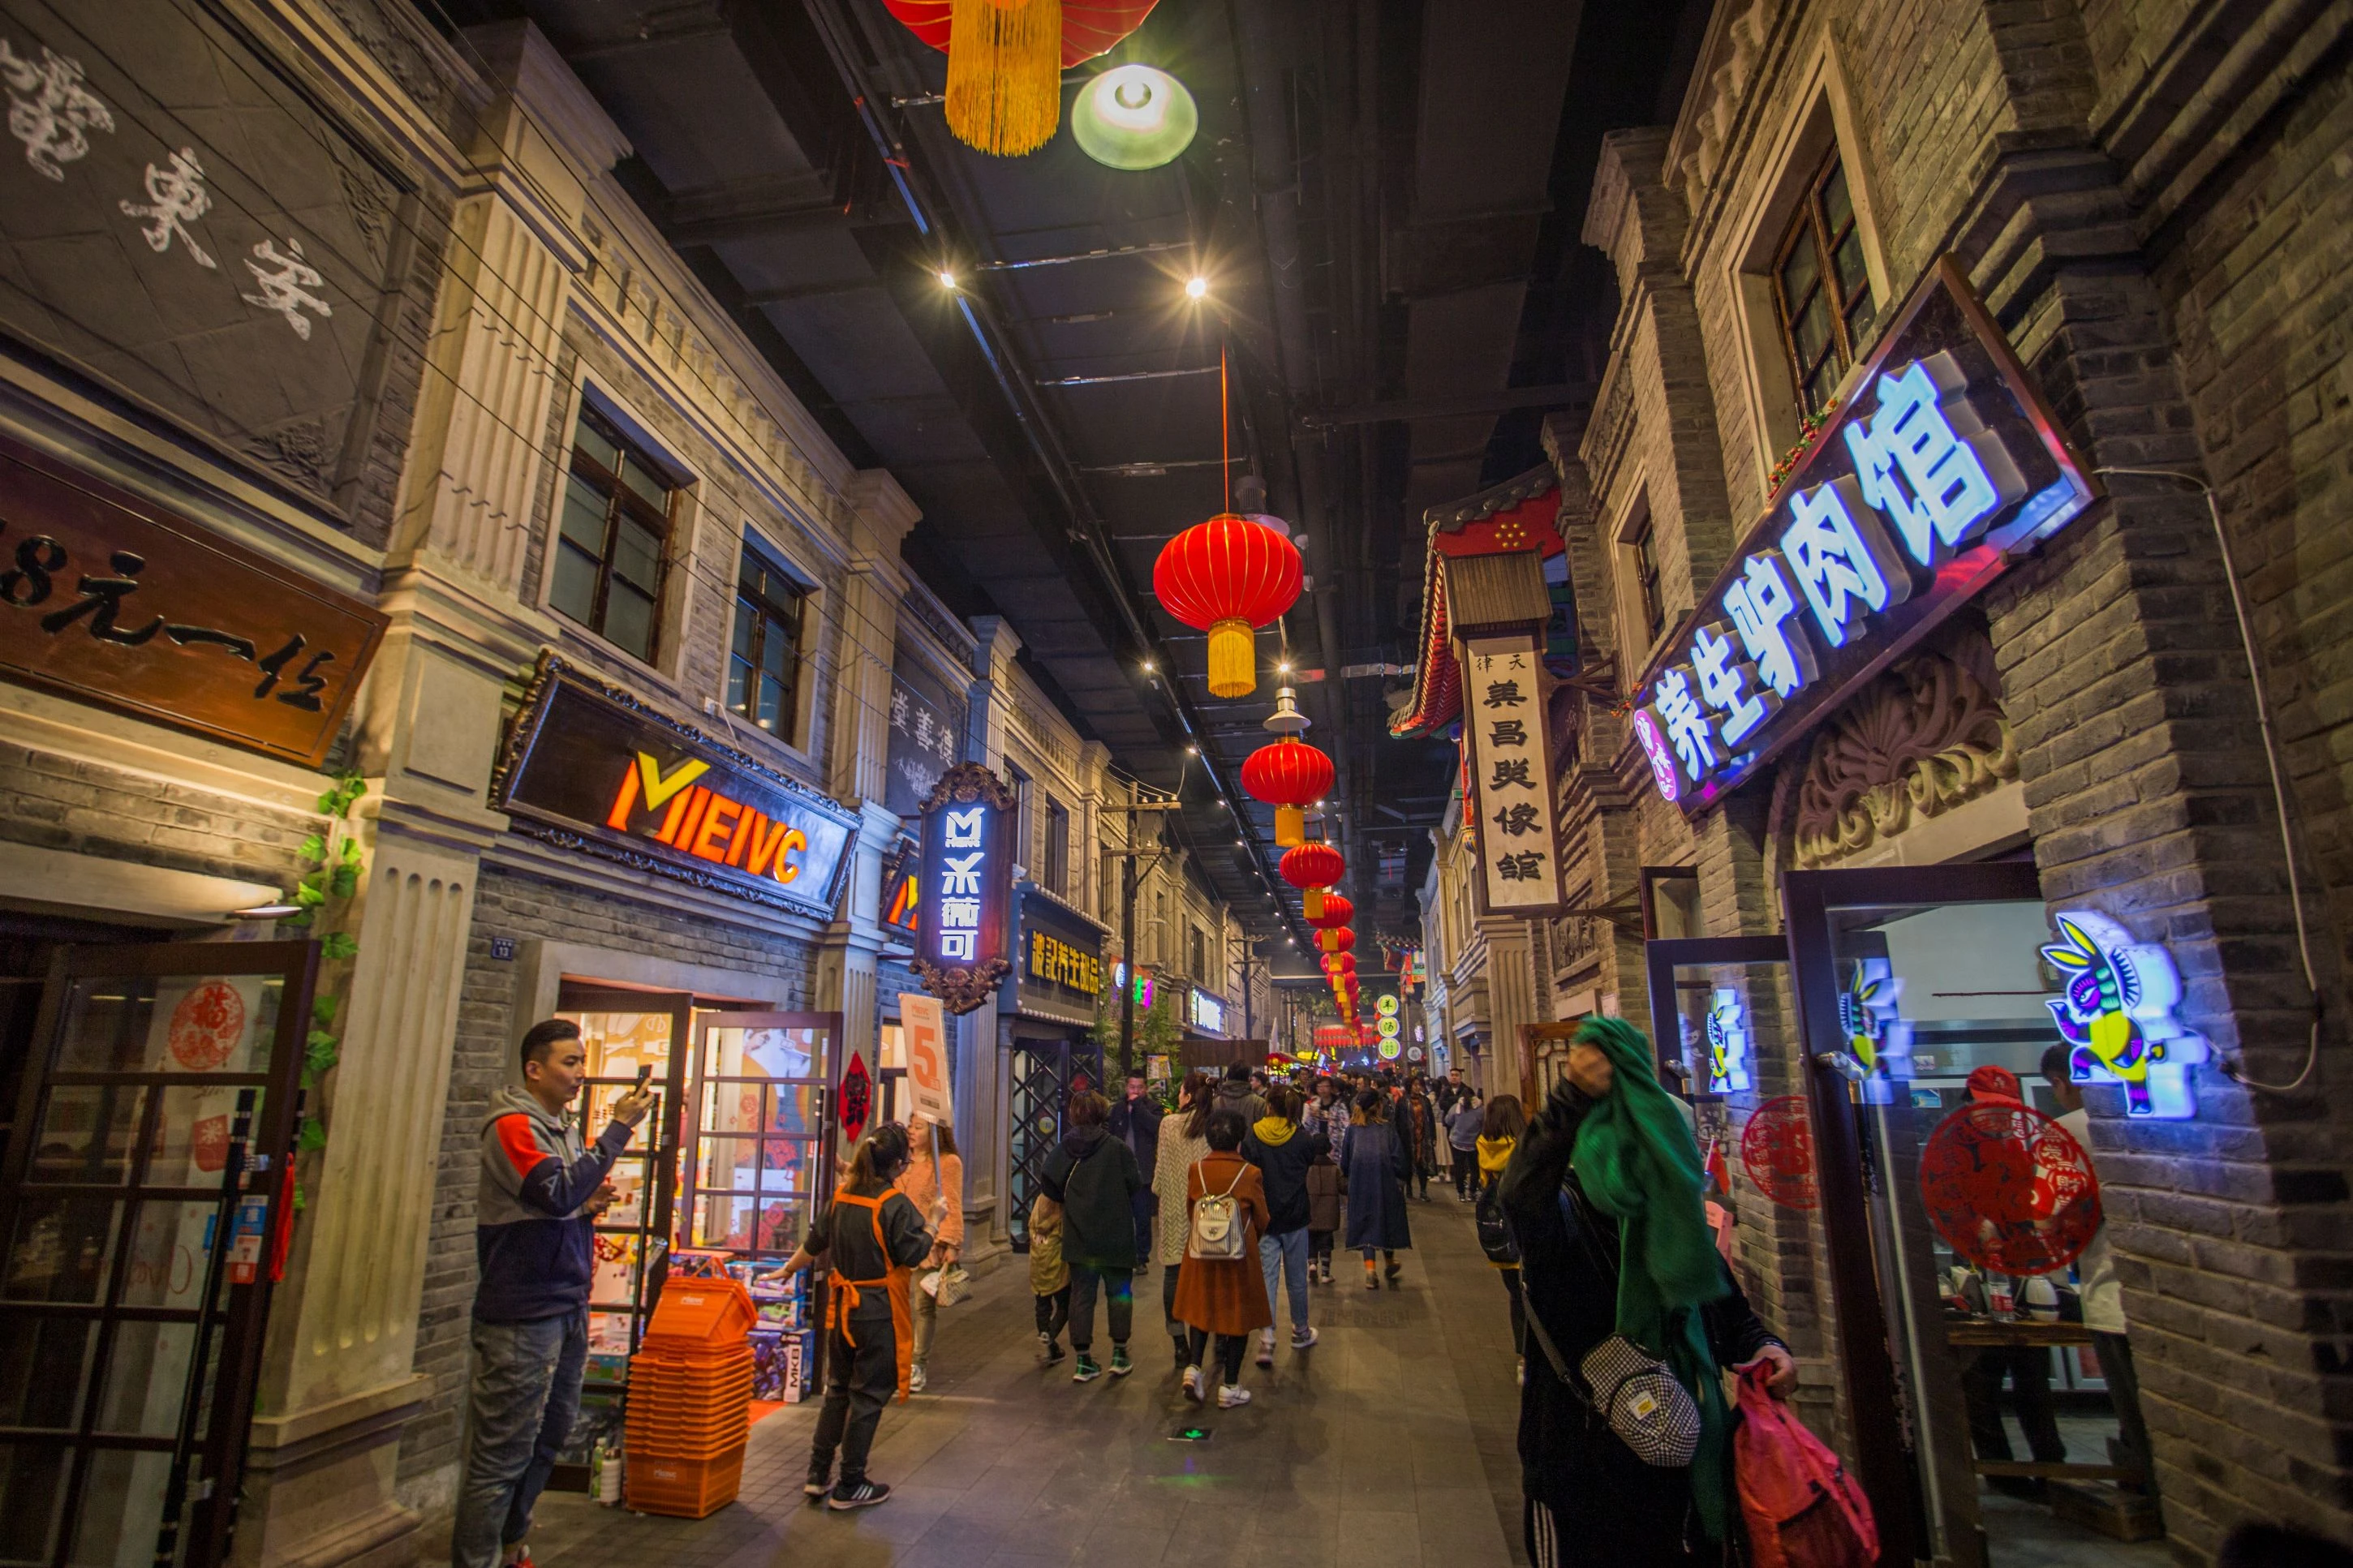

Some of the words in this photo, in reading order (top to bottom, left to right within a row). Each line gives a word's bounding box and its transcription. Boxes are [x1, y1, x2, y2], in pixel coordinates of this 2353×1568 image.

[1655, 359, 1999, 781] 养生驴肉馆
